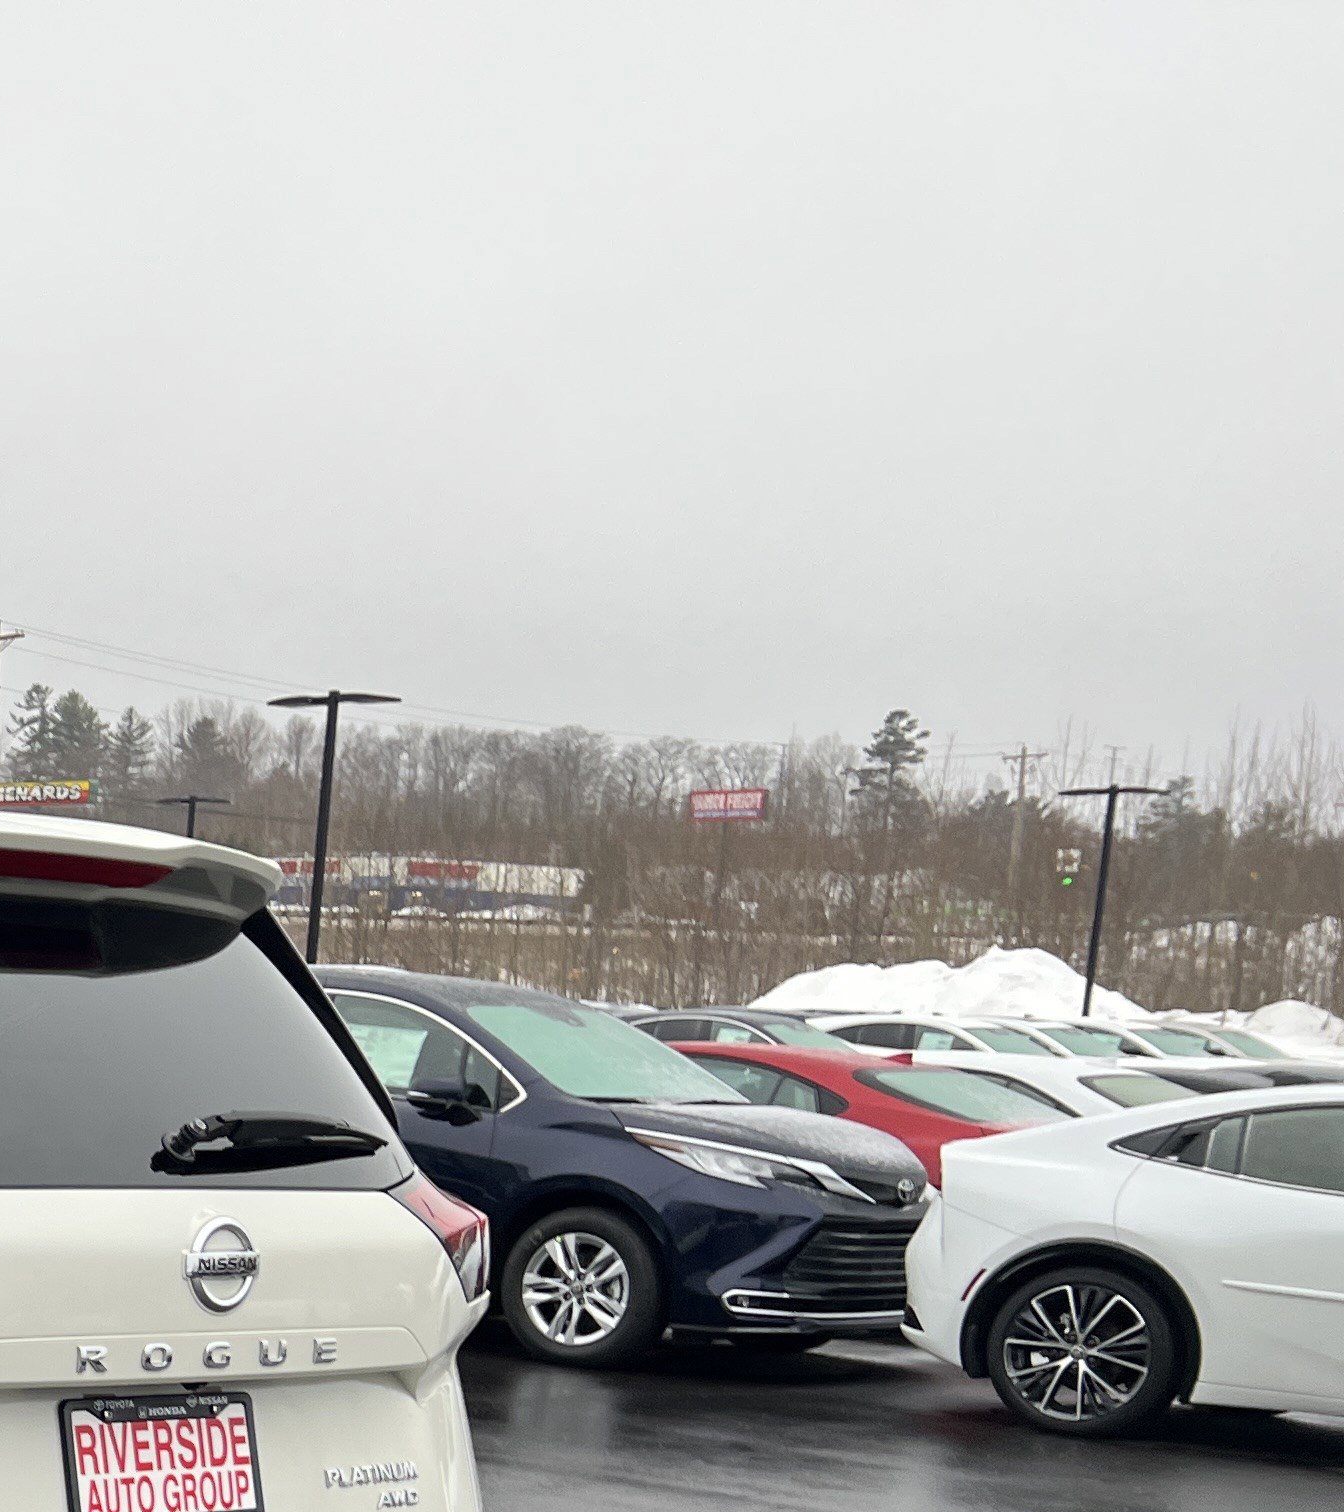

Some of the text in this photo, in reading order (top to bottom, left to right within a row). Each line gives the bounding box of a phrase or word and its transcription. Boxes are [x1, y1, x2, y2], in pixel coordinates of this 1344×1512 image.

[197, 1255, 258, 1272] NISSAN
[76, 1337, 338, 1374] ROGUE
[75, 1416, 252, 1475] RIVERSIDE
[324, 1461, 418, 1488] PLATINUM
[376, 1488, 419, 1510] AWD
